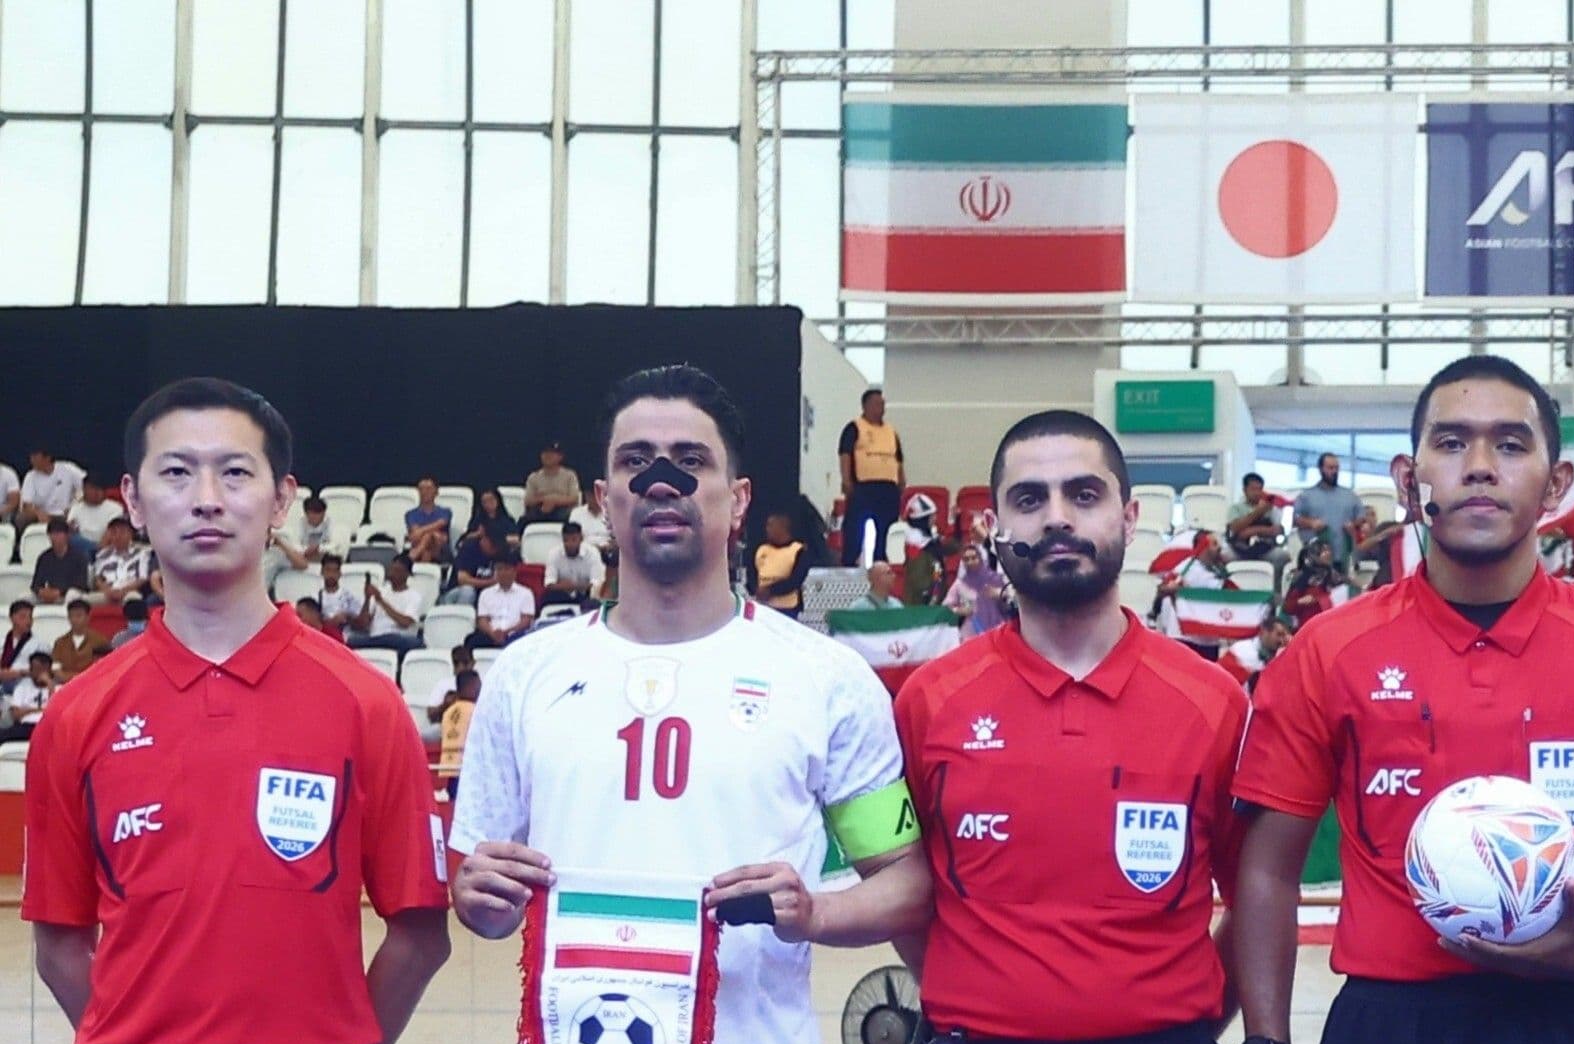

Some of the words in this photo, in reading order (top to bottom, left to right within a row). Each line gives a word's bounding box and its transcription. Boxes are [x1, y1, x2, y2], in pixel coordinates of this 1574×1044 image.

[1123, 389, 1160, 405] EXIT
[1370, 691, 1414, 700] KELME
[112, 736, 154, 751] KELME
[963, 739, 1005, 750] KELME
[616, 716, 692, 801] 10
[267, 776, 326, 802] FIFA
[1366, 768, 1421, 796] AFC
[272, 805, 316, 820] FUTSAL
[1123, 809, 1180, 831] FIFA
[113, 803, 163, 843] AFC
[268, 816, 318, 831] REFEREE
[957, 813, 1010, 841] AFC
[275, 838, 306, 853] 2026
[1129, 839, 1171, 850] FUTSAL
[1126, 850, 1173, 861] REFEREE
[1134, 871, 1163, 884] 2026
